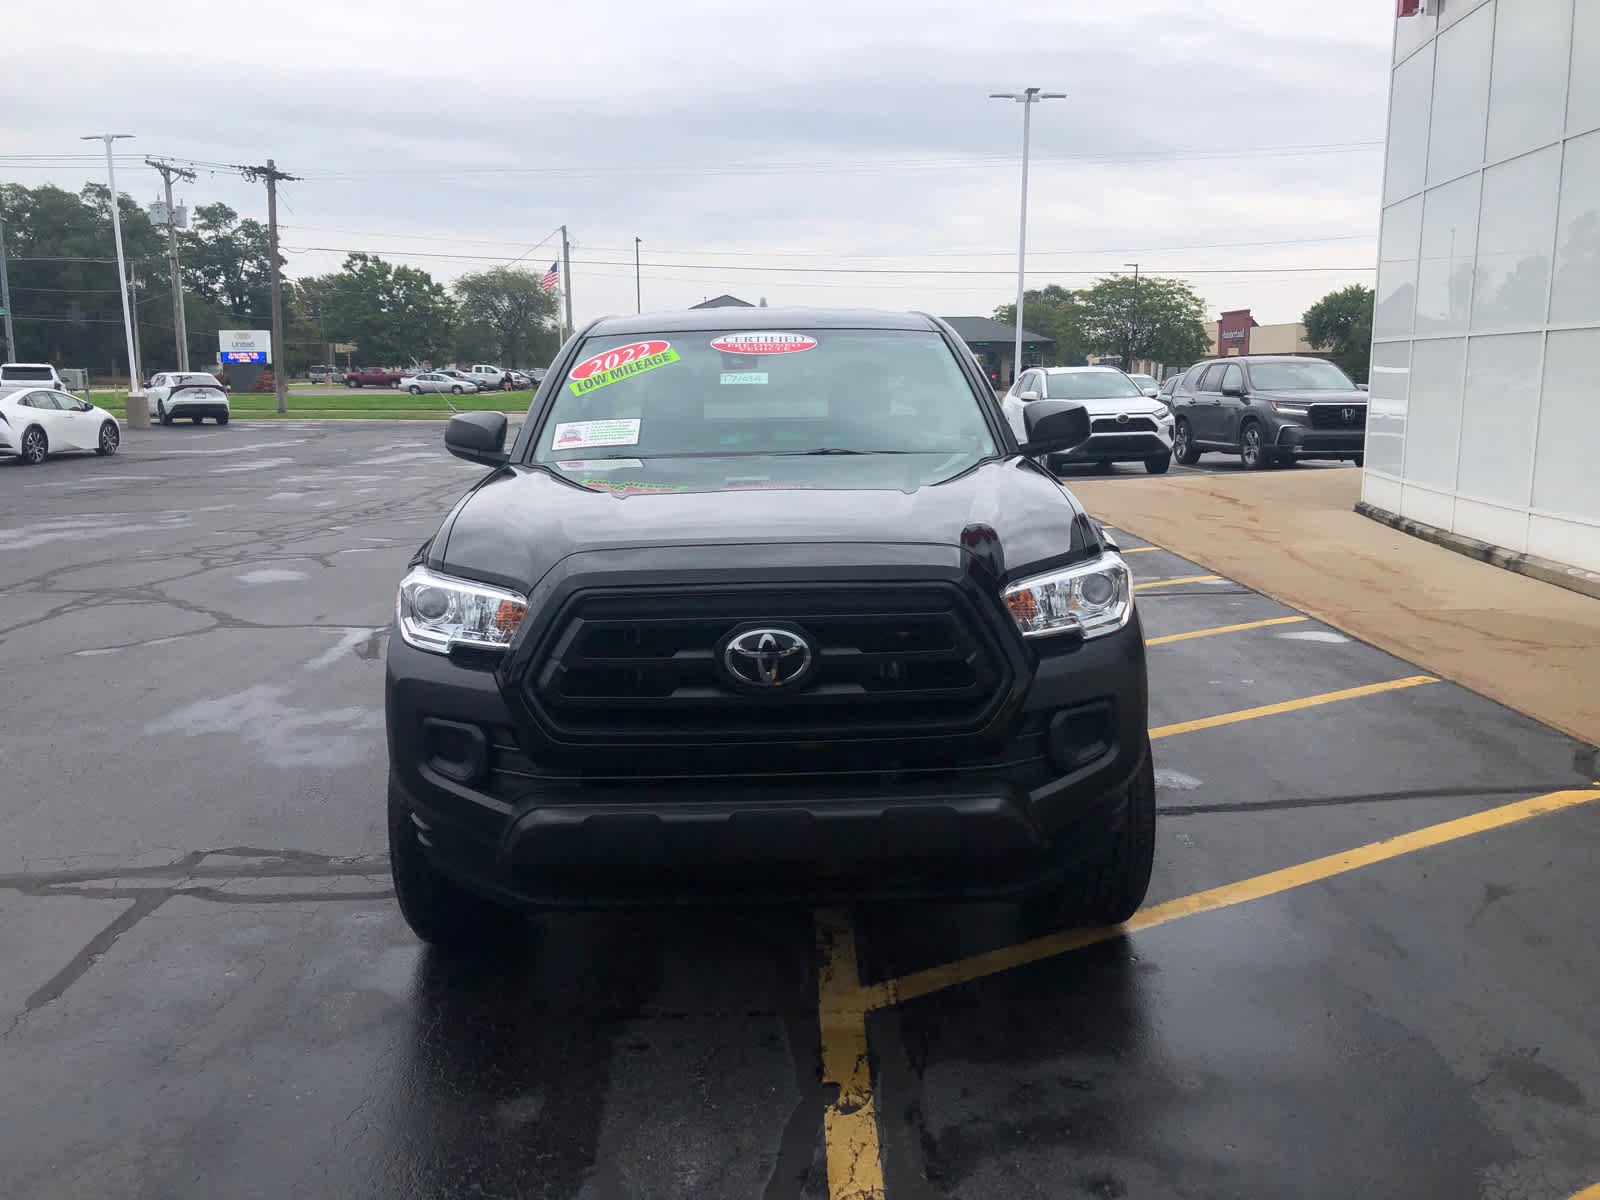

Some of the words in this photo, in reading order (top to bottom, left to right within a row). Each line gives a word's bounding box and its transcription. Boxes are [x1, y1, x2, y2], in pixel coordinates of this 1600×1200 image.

[576, 374, 607, 392] LOW
[609, 352, 672, 380] MILEAGE
[589, 343, 650, 375] 2022
